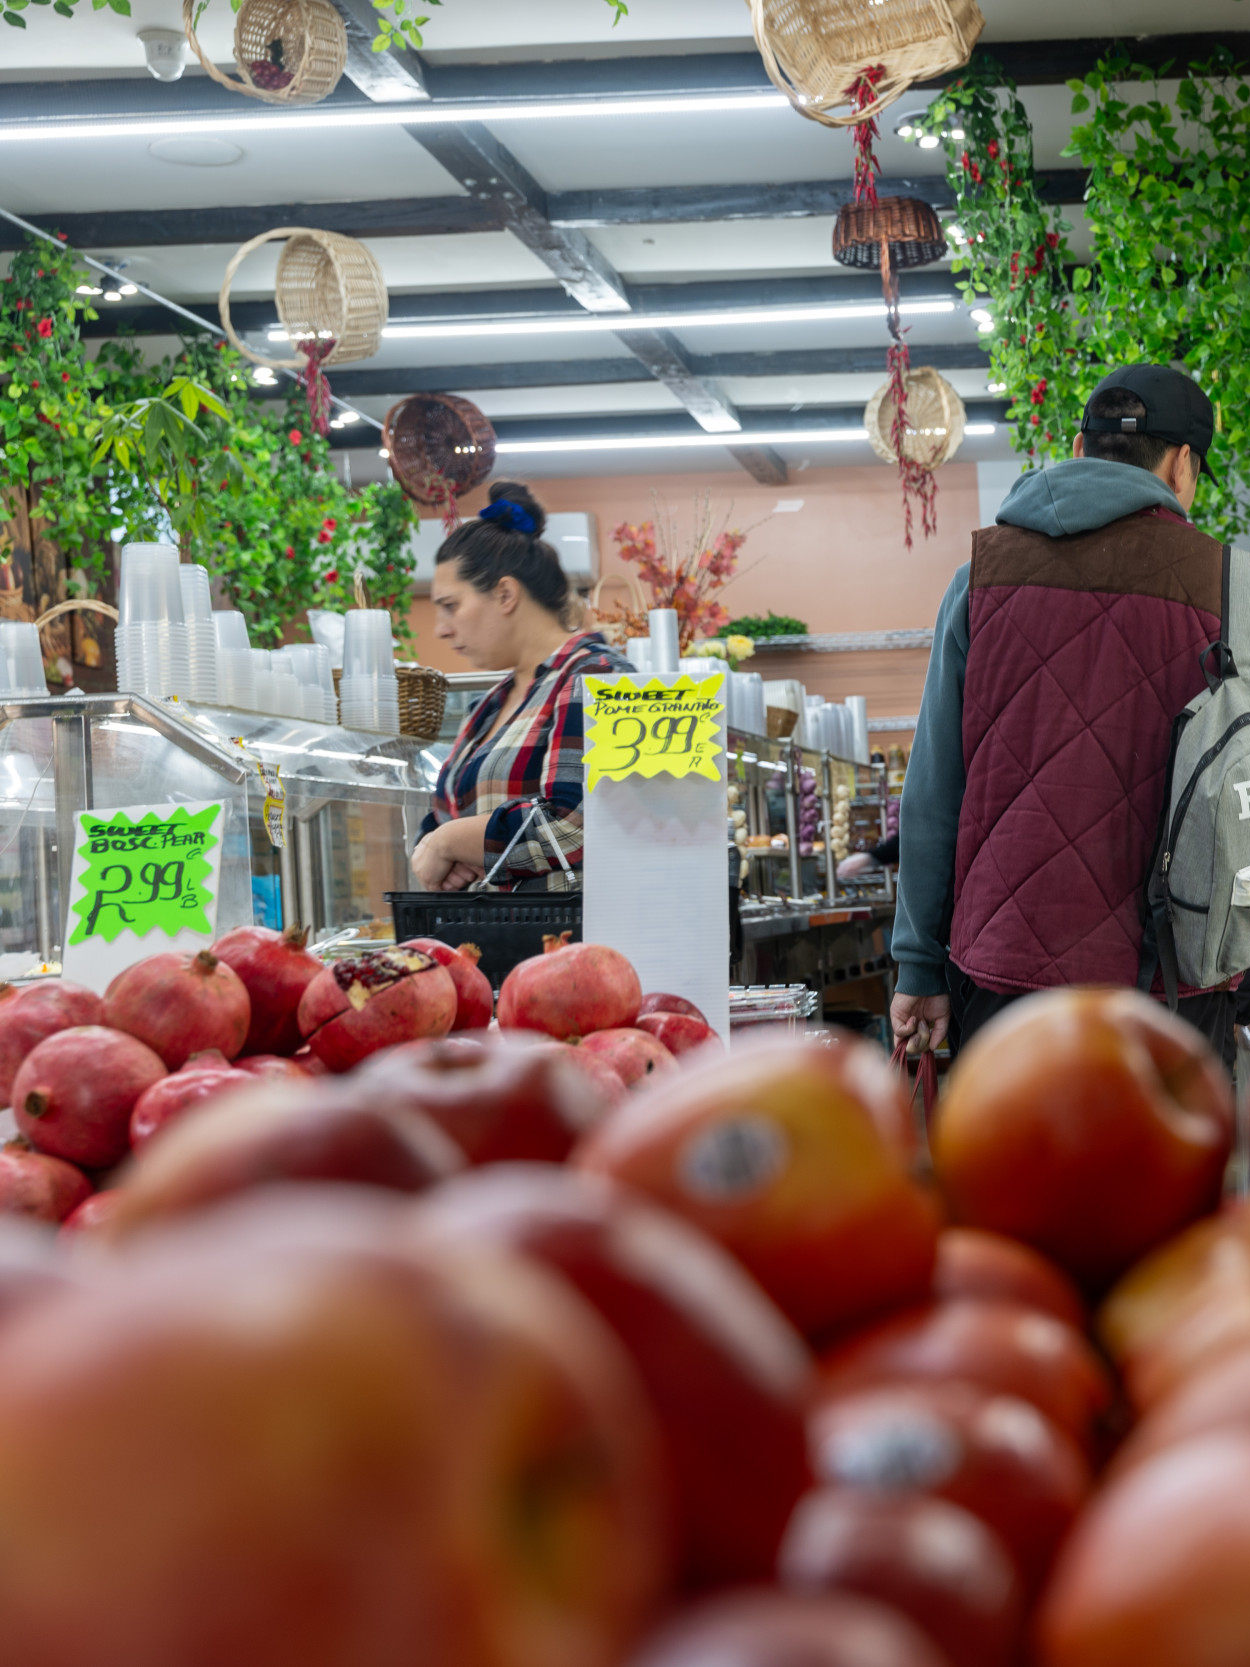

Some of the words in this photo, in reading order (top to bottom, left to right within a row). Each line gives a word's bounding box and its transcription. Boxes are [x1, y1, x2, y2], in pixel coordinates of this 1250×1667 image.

[596, 689, 696, 701] SWEET
[594, 701, 647, 716] POME
[88, 823, 188, 838] SWEET
[161, 832, 206, 849] PEAR
